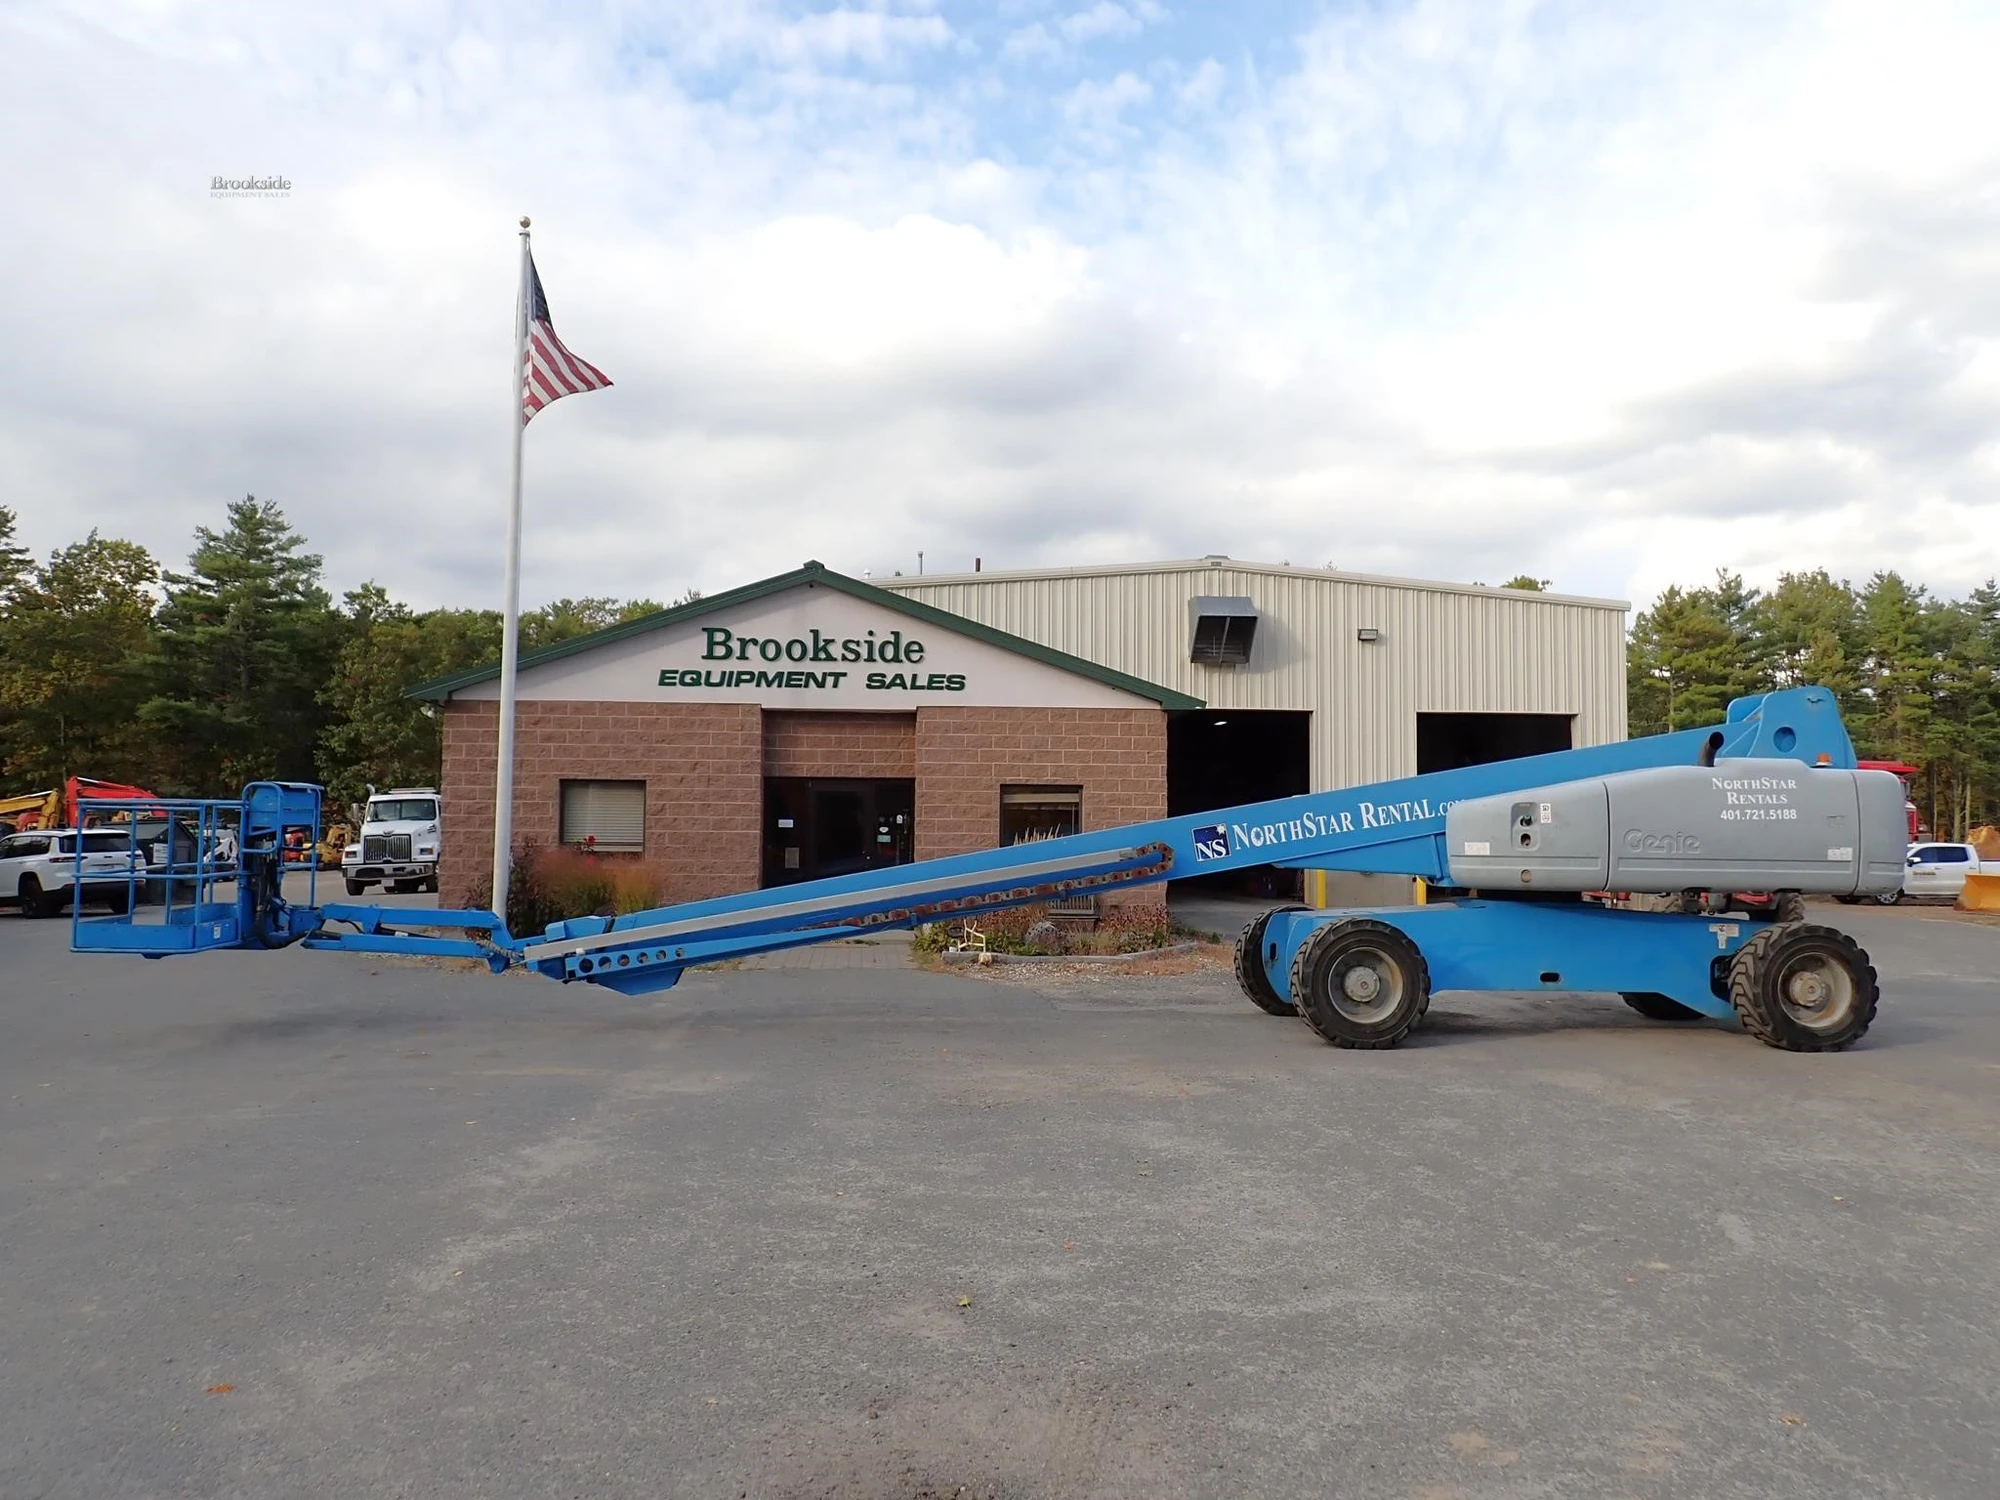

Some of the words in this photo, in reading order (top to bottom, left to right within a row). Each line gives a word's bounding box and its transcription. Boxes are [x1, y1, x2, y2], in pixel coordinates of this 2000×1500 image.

[701, 627, 925, 663] Brookside
[658, 669, 847, 689] EQUIPMENT
[865, 672, 966, 691] SALES
[1726, 791, 1788, 804] RENTALS
[1720, 809, 1797, 820] 401.721.5188
[1195, 839, 1228, 861] NS
[1623, 828, 1700, 854] Genie
